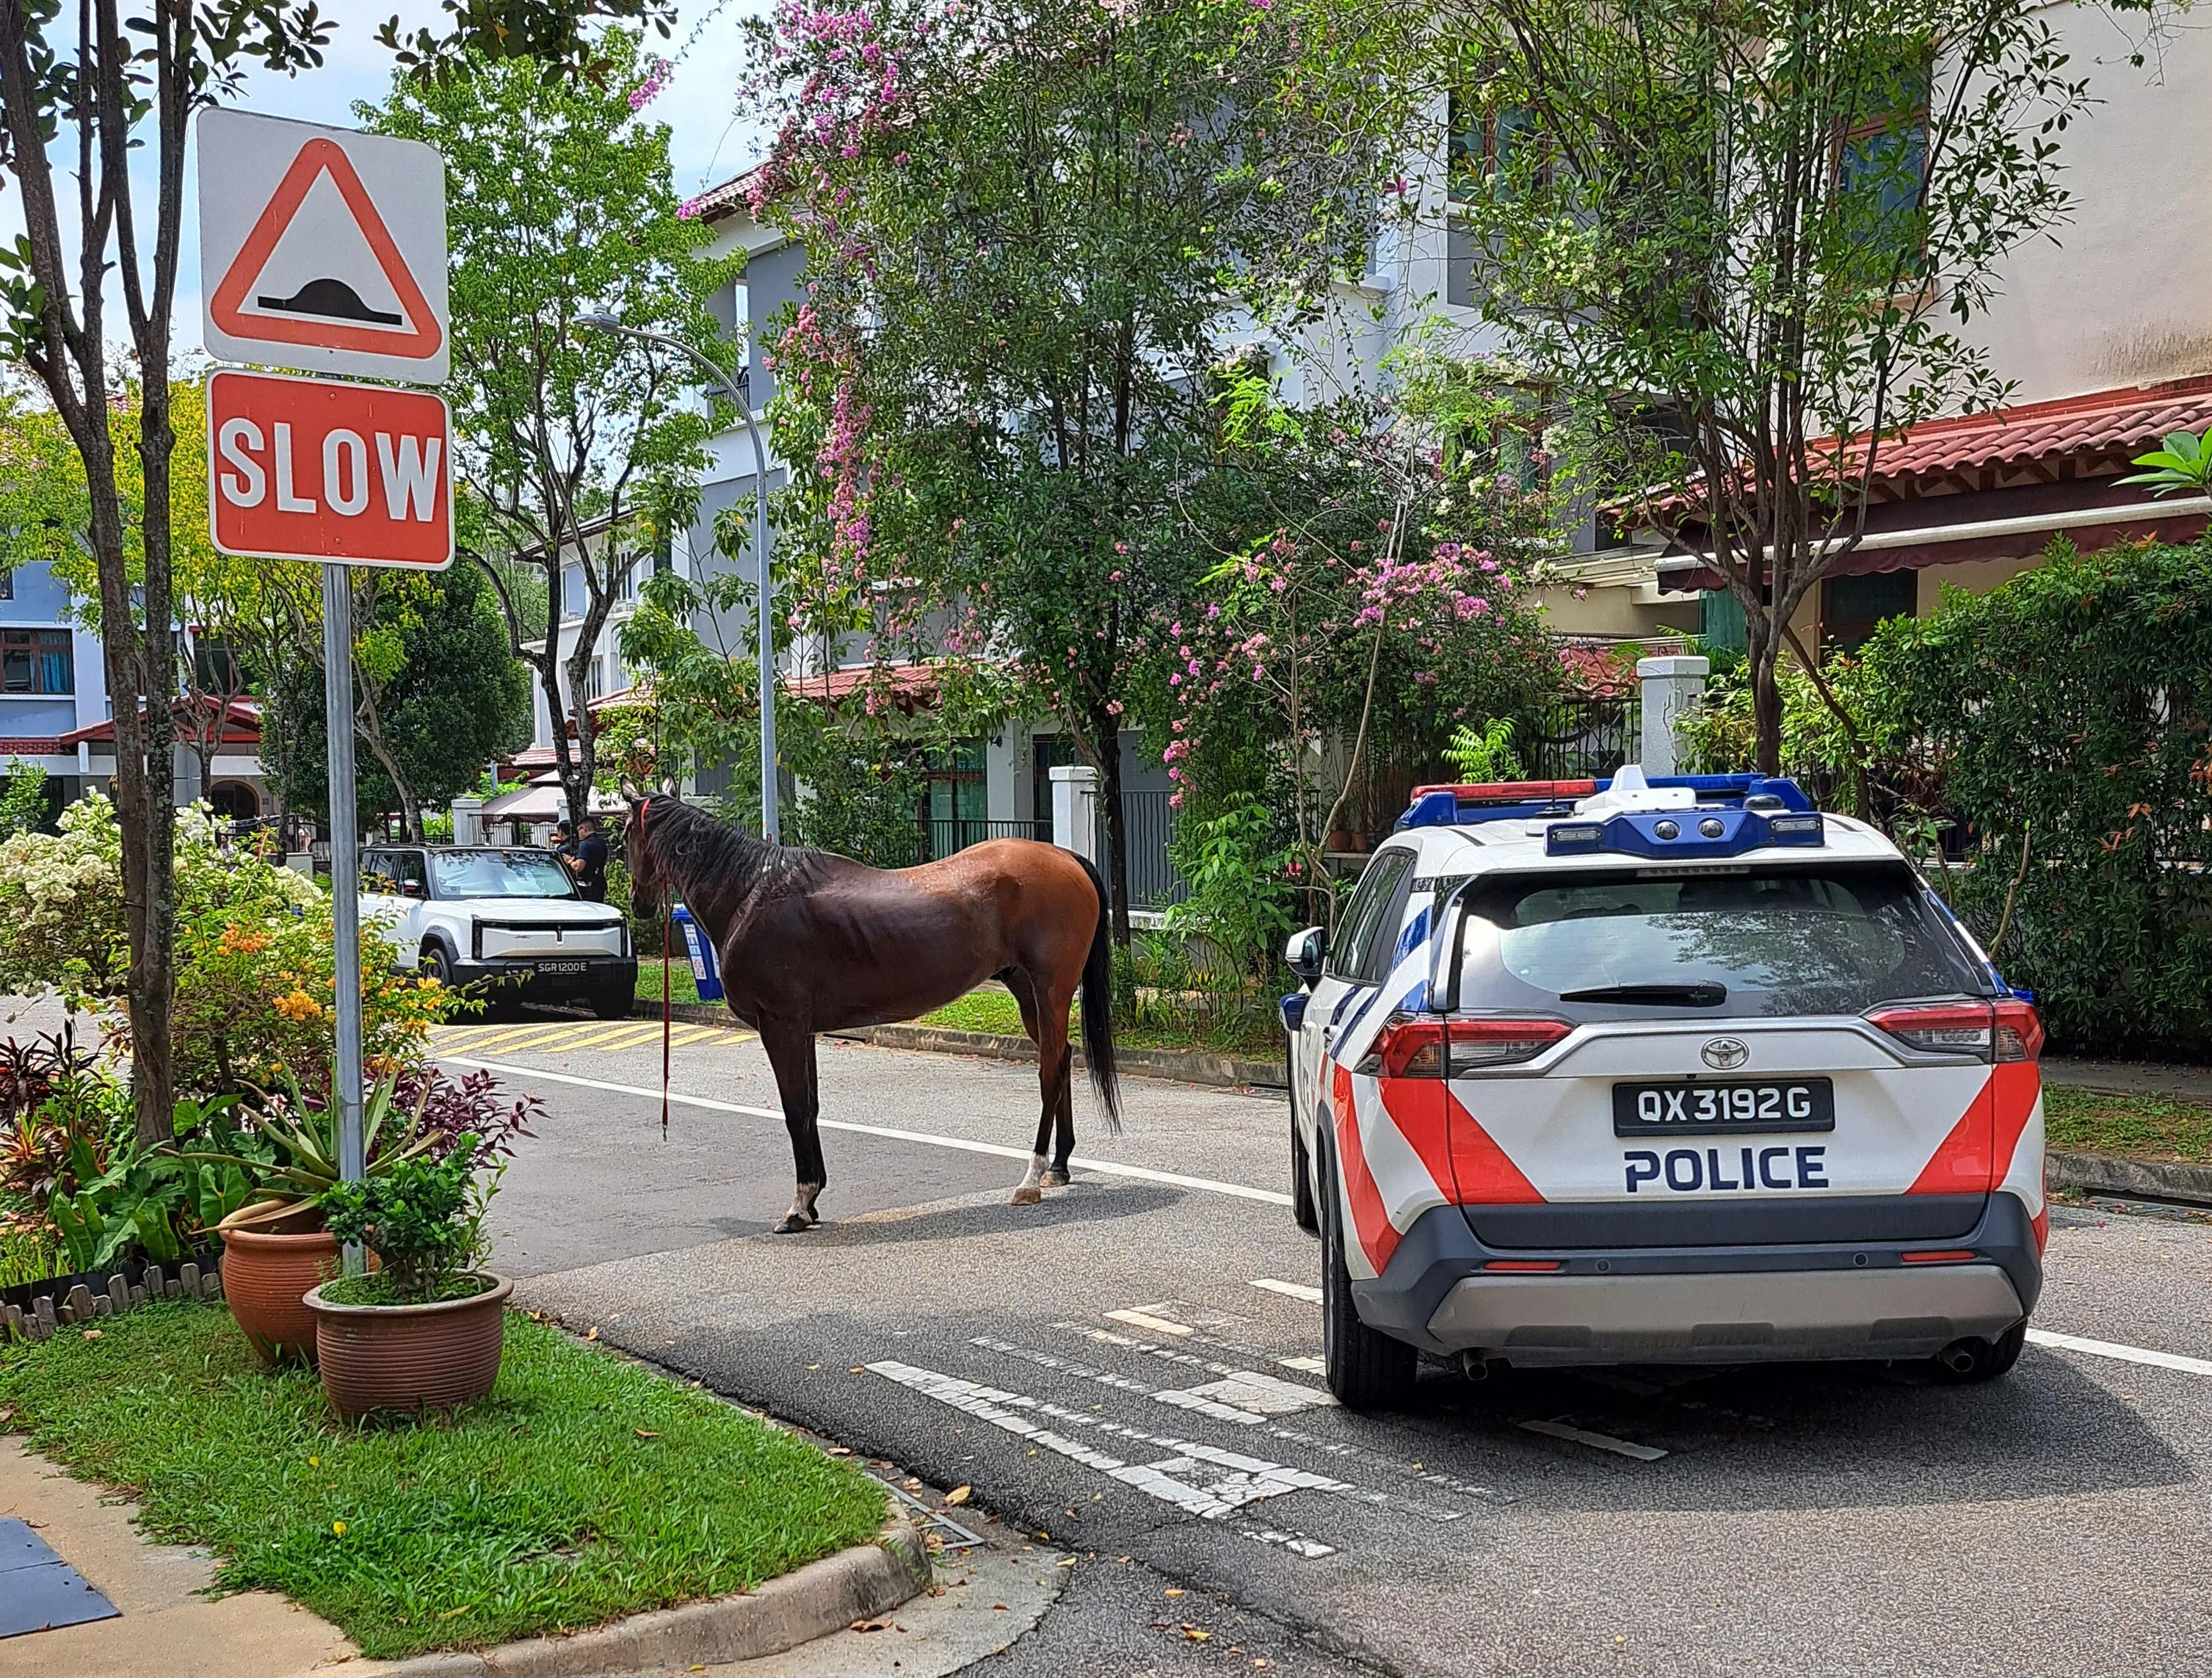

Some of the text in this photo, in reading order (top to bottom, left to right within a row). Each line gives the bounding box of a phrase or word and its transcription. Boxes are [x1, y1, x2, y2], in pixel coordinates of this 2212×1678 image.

[220, 417, 441, 522] SLOW
[538, 962, 587, 972] SGR1200E
[1638, 1087, 1811, 1121] QX3192G
[1624, 1146, 1829, 1193] POLICE
